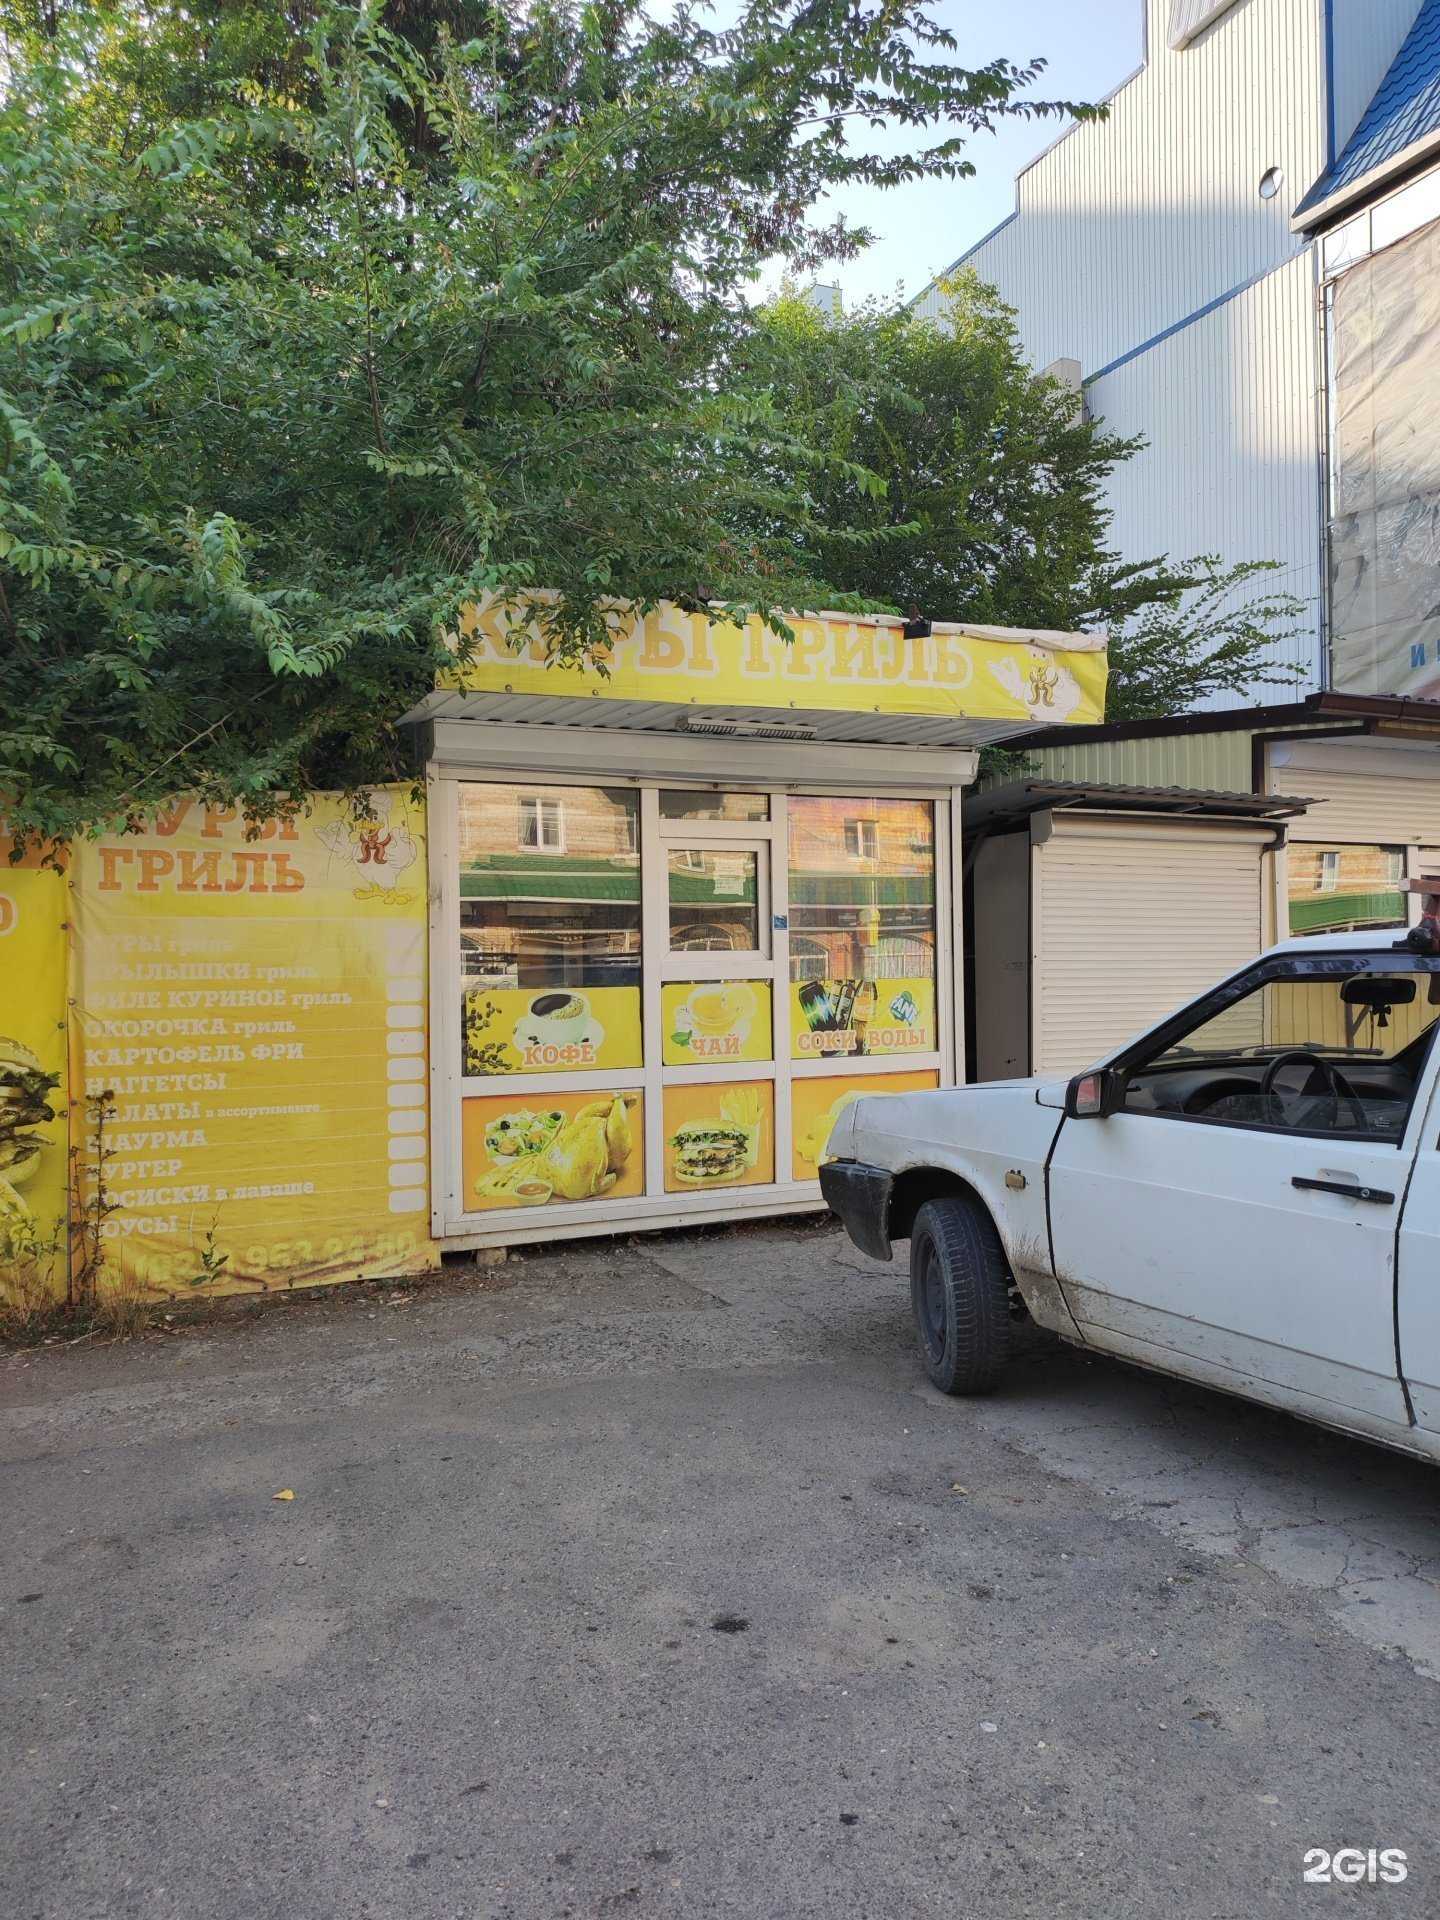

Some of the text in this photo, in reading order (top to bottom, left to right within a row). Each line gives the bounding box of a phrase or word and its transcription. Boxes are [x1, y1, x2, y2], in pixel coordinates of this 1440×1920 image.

[744, 614, 968, 684] ГРИЛЬ
[103, 793, 299, 840] УРЫ
[98, 847, 306, 893] ГРИЛЬ
[167, 989, 287, 1009] КУРИНОЕ
[291, 993, 353, 1009] гриль
[84, 1018, 297, 1038] ОКОРОЧКА гриль
[798, 1028, 928, 1051] СОКИ ВОДЫ
[84, 1042, 305, 1067] КАРТОФЕЛЬ ФРИ
[523, 1042, 596, 1067] КОФЕ
[691, 1033, 741, 1057] ЧАЙ
[84, 1072, 227, 1096] НАГГЕТСЫ
[234, 1181, 315, 1200] лаваше
